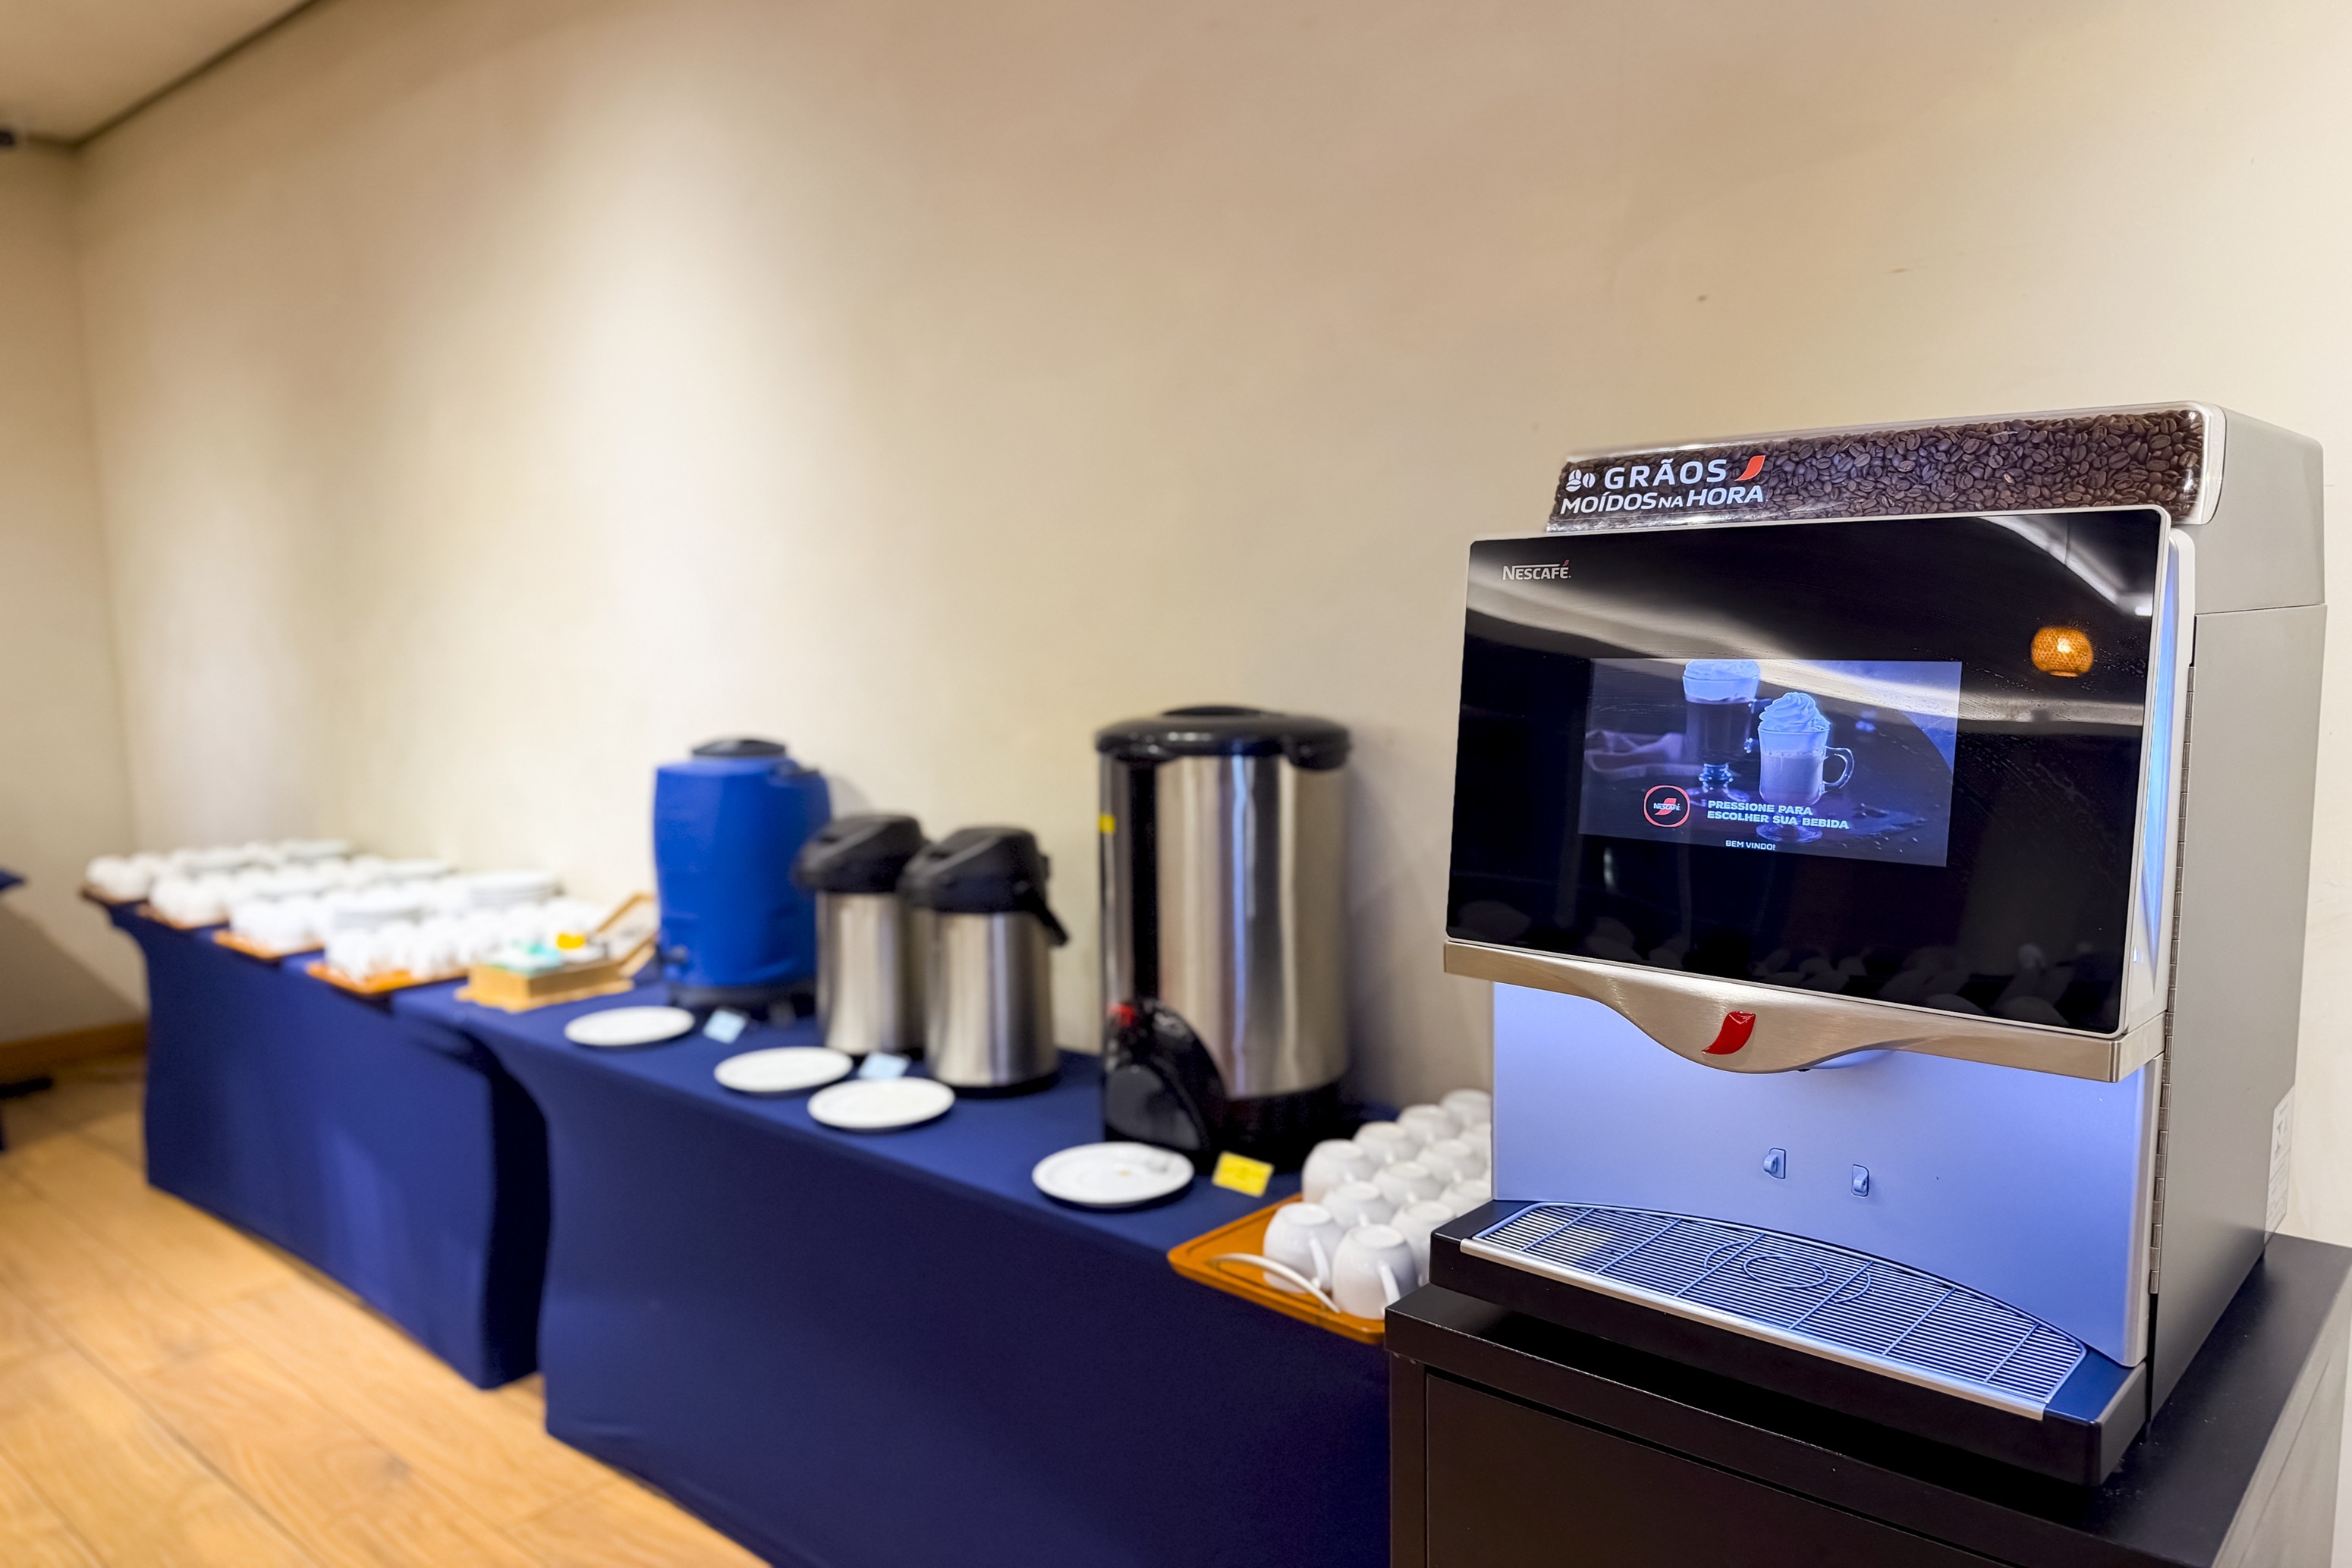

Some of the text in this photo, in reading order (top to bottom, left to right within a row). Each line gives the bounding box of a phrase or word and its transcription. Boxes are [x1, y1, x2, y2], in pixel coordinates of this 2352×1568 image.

[1604, 458, 1728, 489] GRÃOS
[1560, 485, 1764, 514] MOÍDOS NA HORA
[1708, 800, 1813, 815] PRESSIONE PARA
[1707, 811, 1850, 829] ESCOLHER SUA BEBIDA
[1725, 840, 1776, 850] BEM VINDO!
